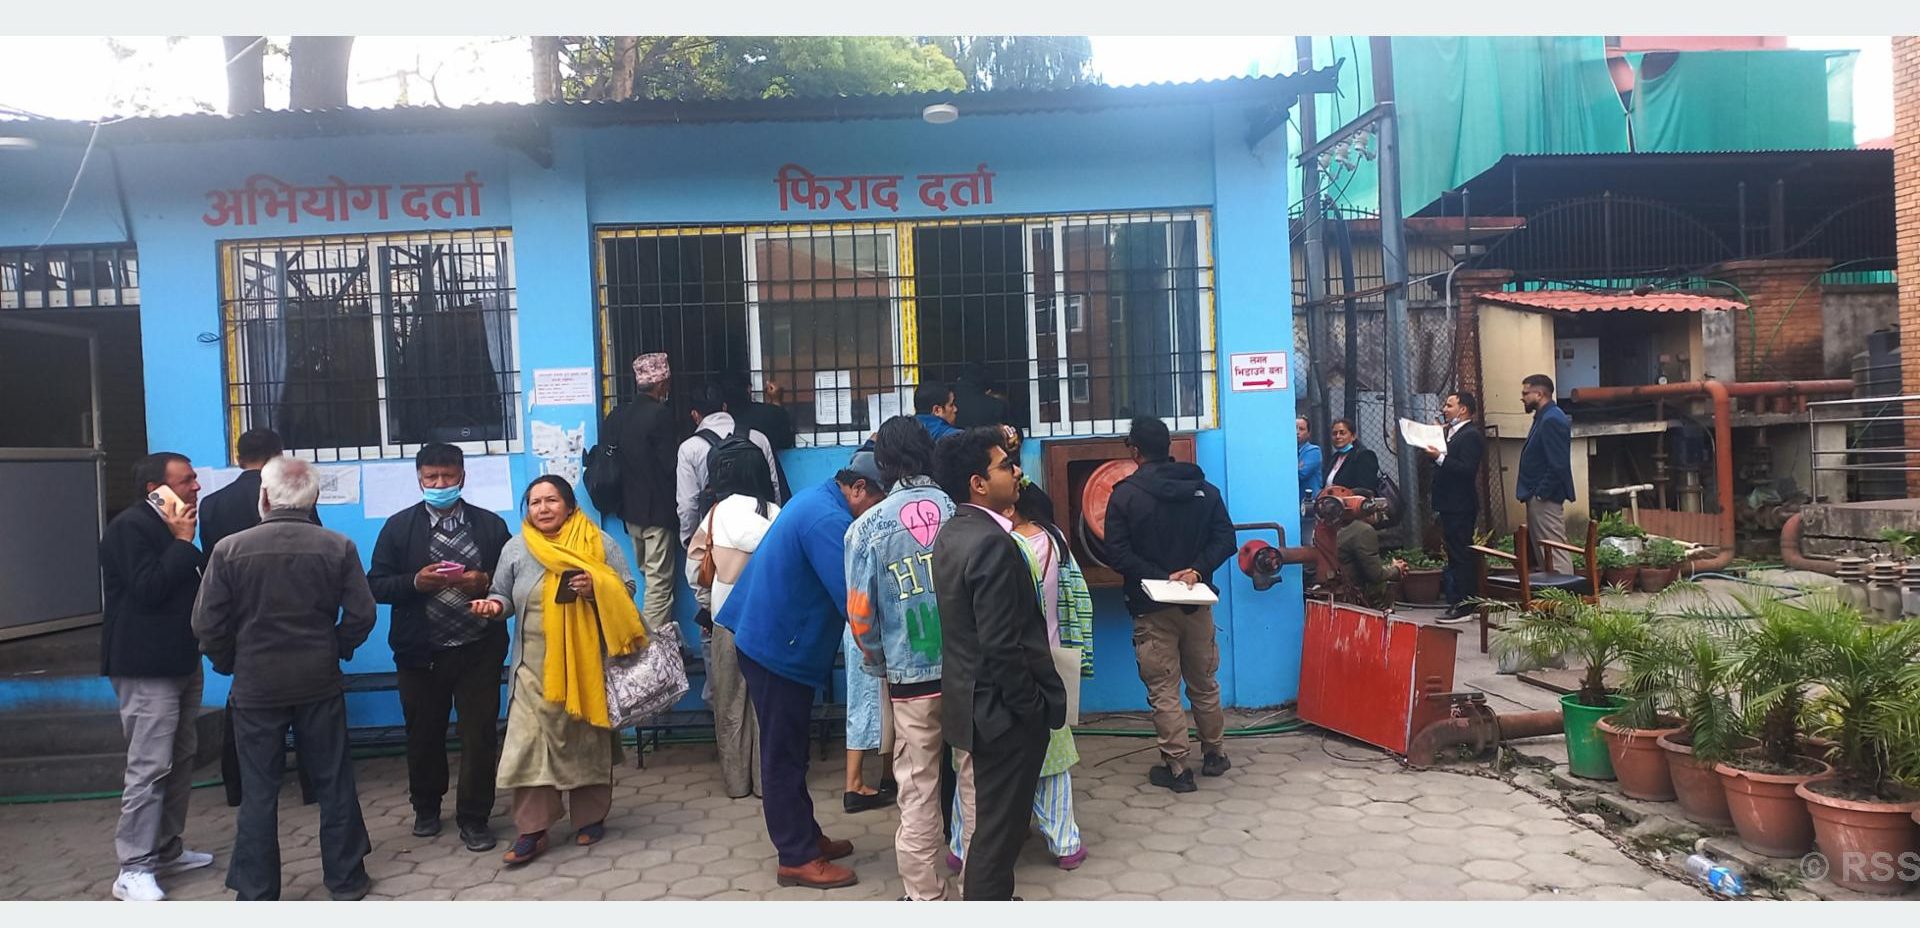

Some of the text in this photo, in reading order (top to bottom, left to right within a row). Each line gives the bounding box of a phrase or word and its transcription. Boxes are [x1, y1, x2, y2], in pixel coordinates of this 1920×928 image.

[202, 171, 484, 227] अभियोग दर्ता
[773, 162, 997, 212] फिराद दर्ता
